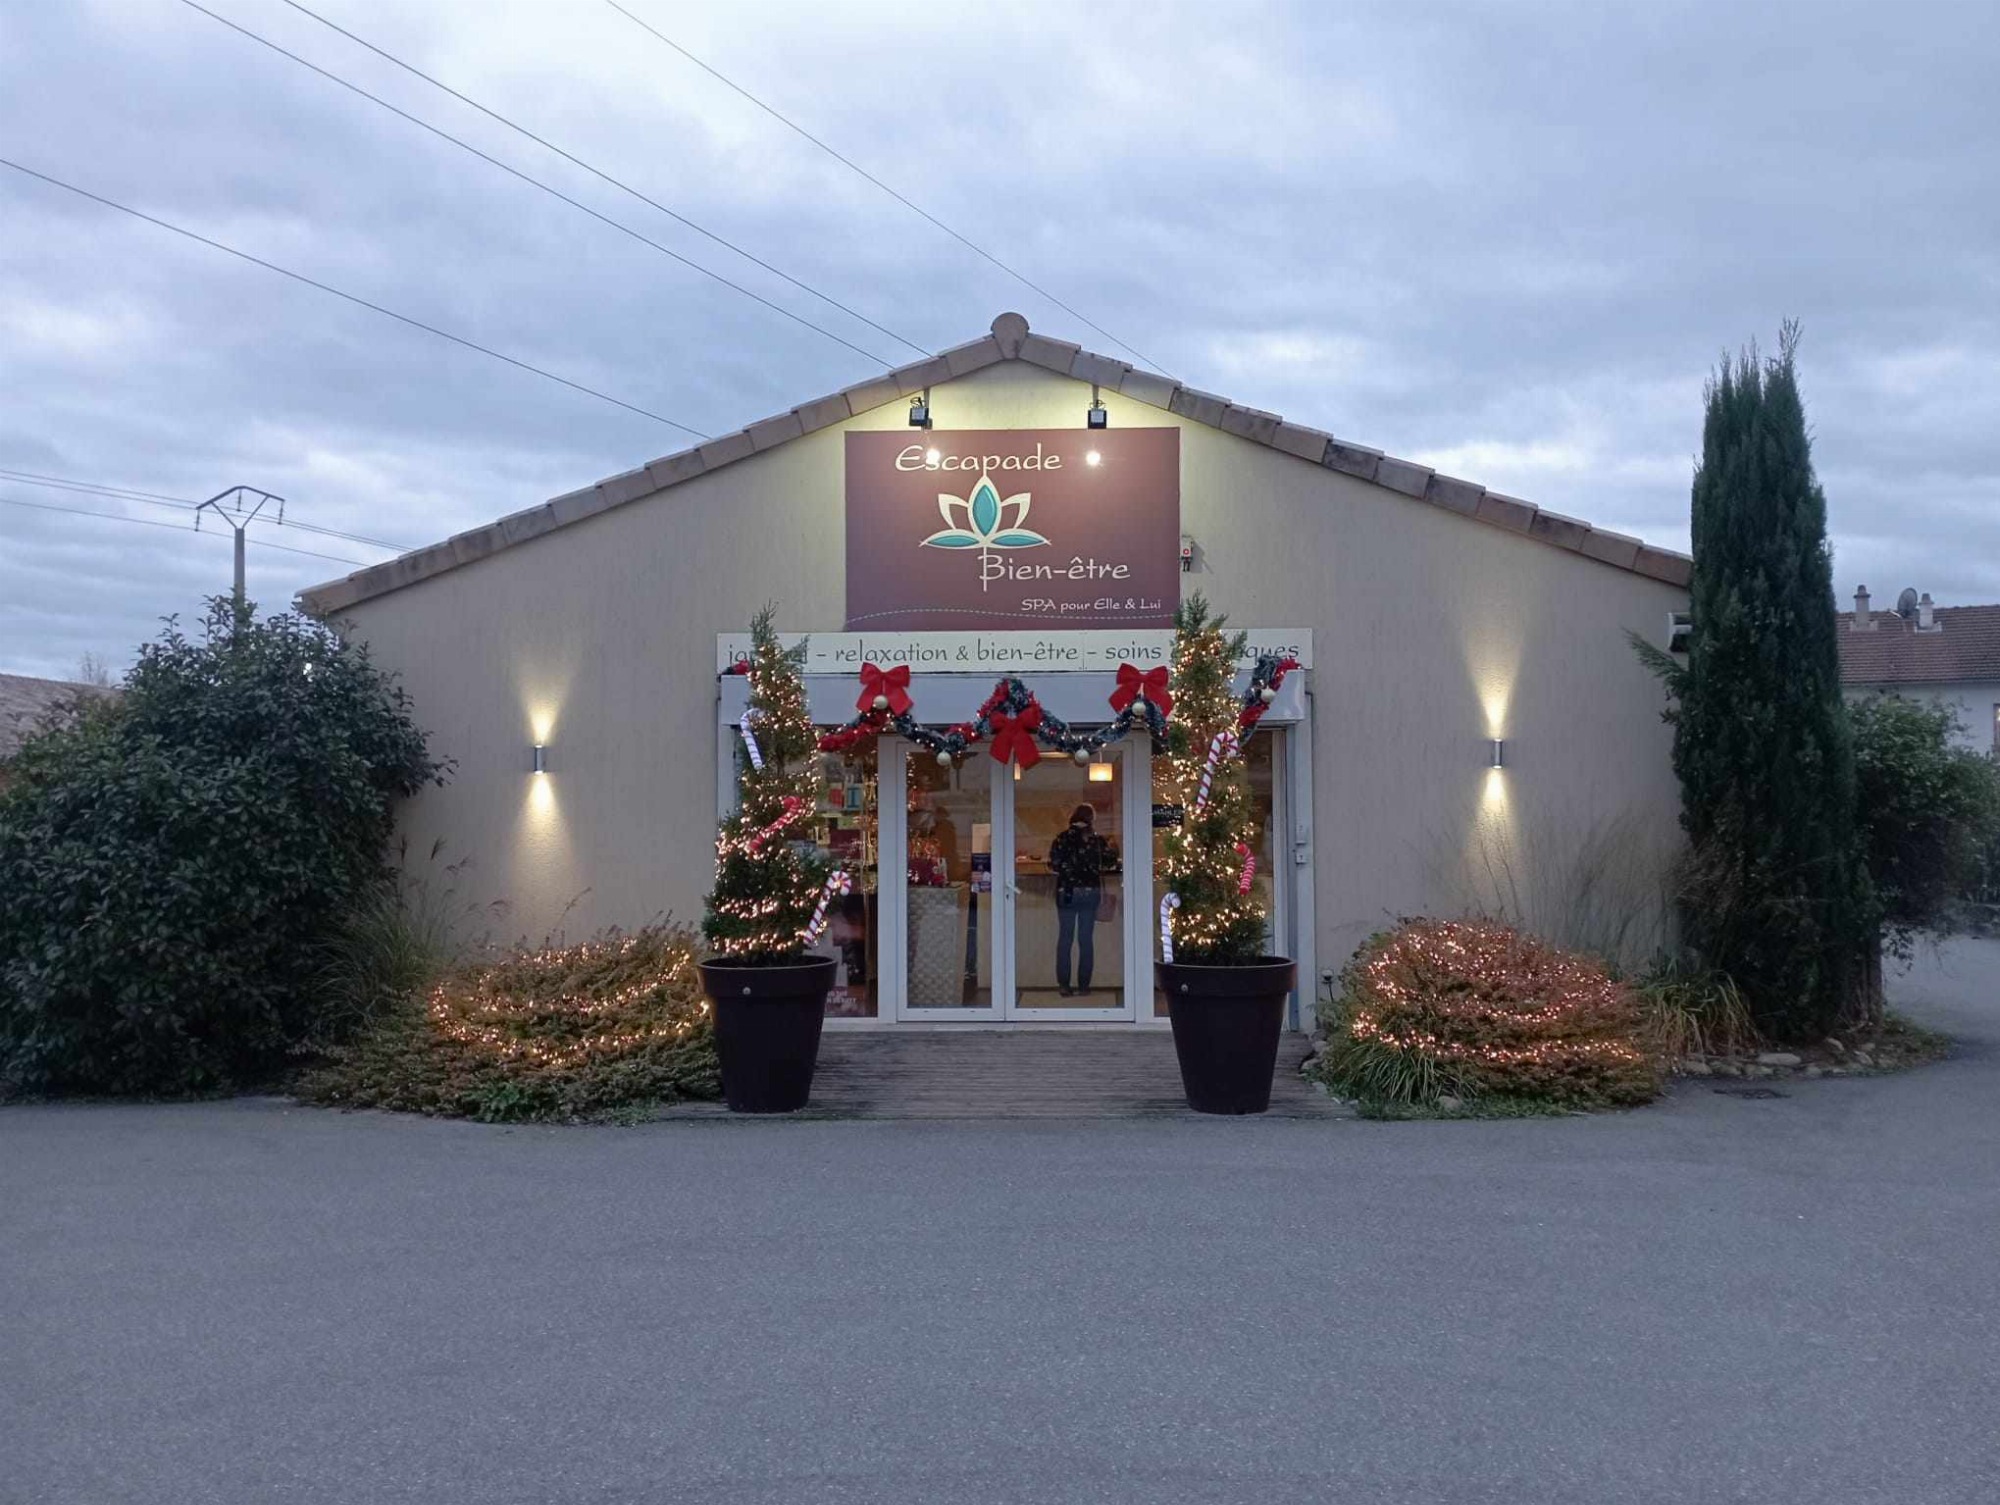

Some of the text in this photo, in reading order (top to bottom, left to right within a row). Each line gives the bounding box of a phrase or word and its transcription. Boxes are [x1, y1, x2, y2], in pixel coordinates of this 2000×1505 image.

[895, 443, 1062, 477] Escapade
[977, 553, 1131, 592] Bien-être
[1021, 598, 1161, 613] SPA pour Elle & Lui
[835, 639, 948, 664] relaxation
[956, 647, 969, 662] &
[977, 638, 1077, 661] bien-être
[1105, 640, 1162, 660] soins
